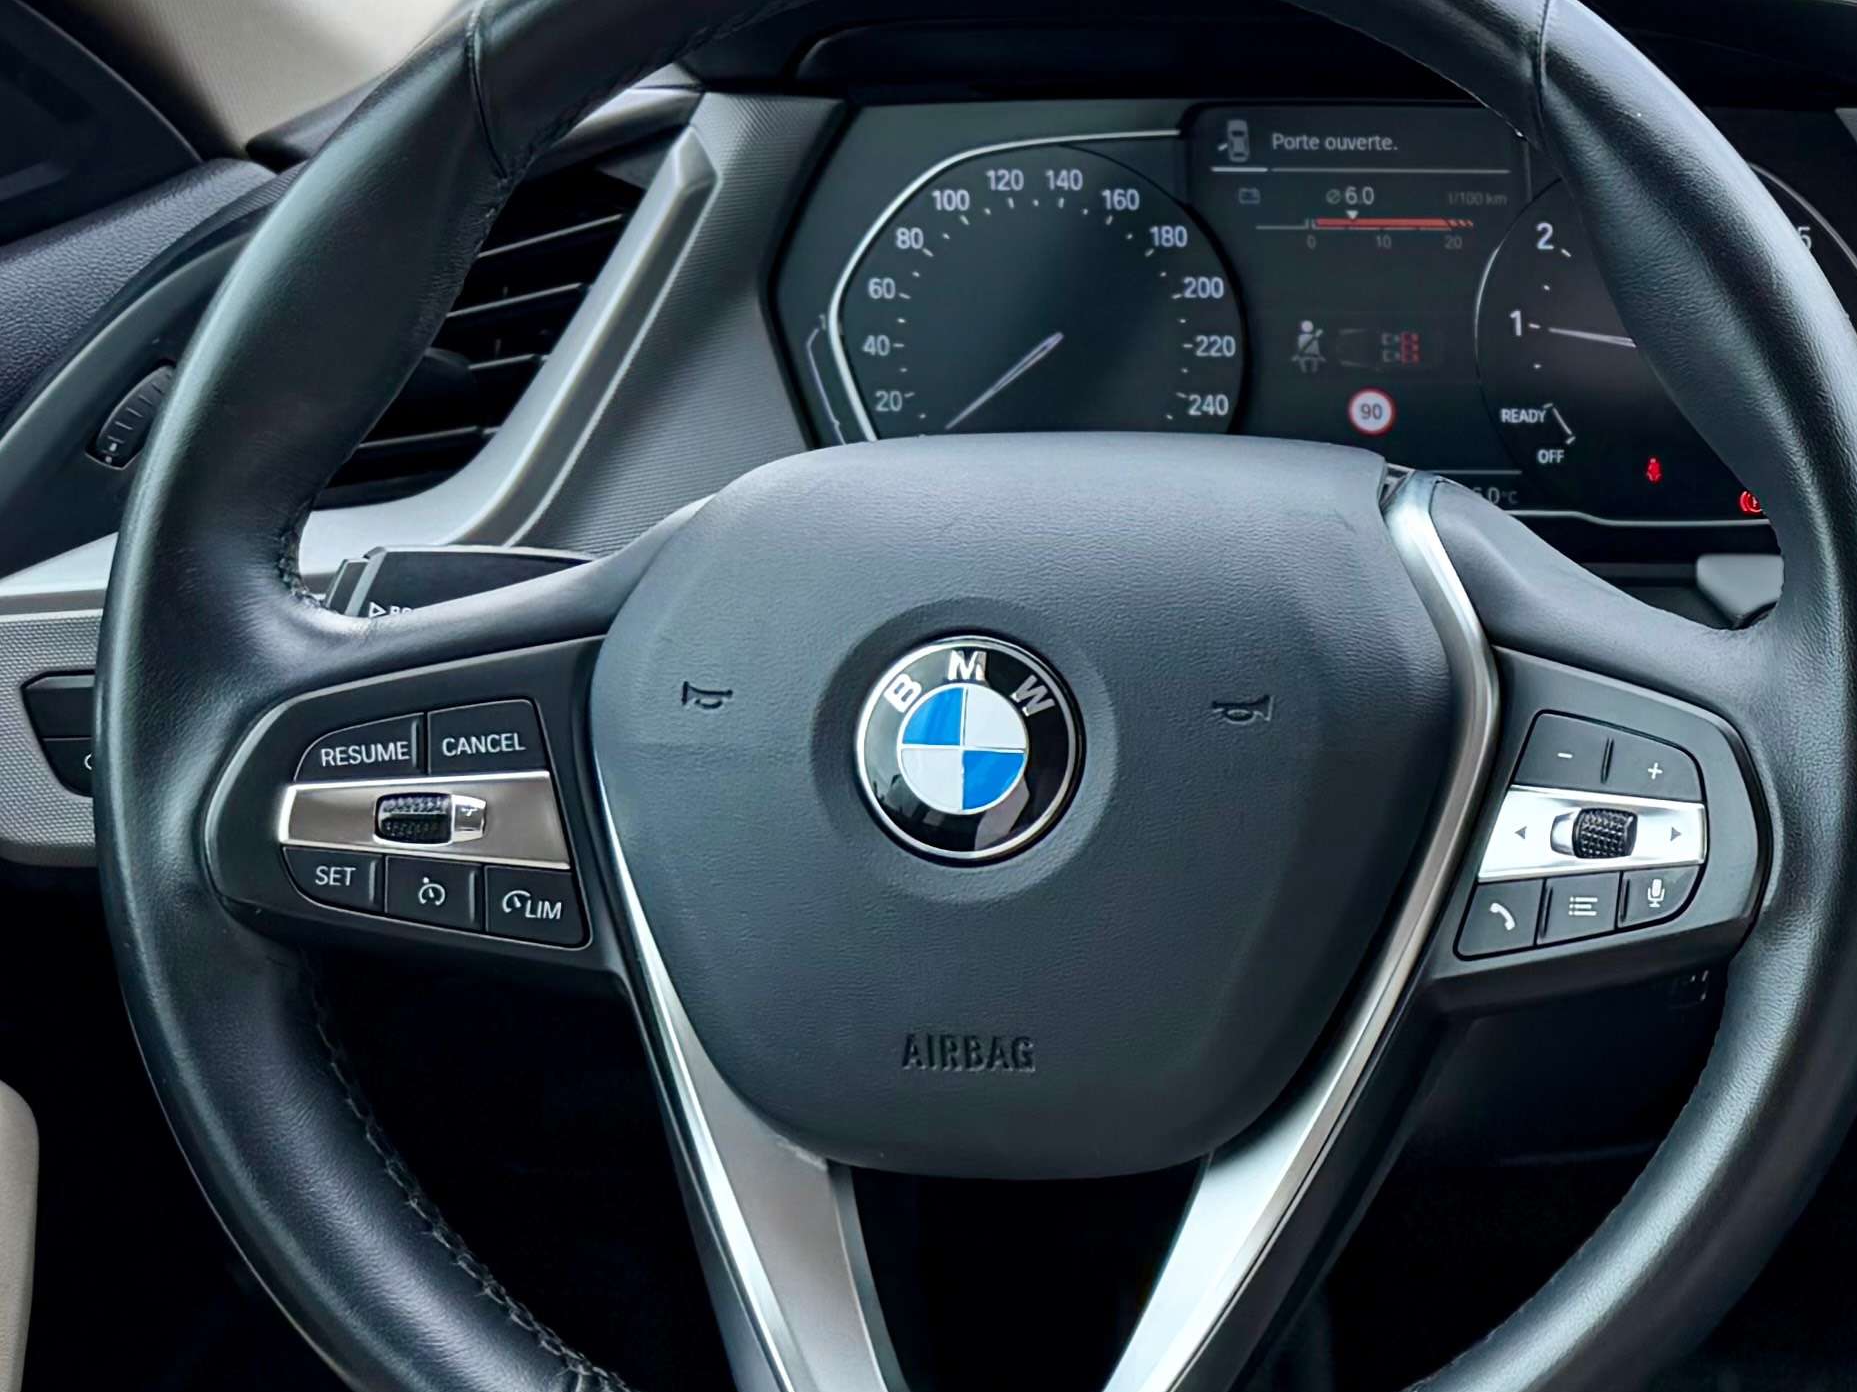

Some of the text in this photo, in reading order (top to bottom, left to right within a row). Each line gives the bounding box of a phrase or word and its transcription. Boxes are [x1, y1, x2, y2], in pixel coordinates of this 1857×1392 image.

[1272, 133, 1398, 151] Porte ouverte.
[987, 169, 1023, 191] 120
[1046, 169, 1083, 191] 140
[933, 190, 969, 211] 100
[1103, 189, 1140, 211] 160
[896, 227, 924, 250] 80
[1151, 226, 1188, 248] 180
[1376, 235, 1392, 249] 10
[1444, 235, 1463, 249] 20
[1536, 222, 1555, 250] 2
[868, 278, 896, 299] 60
[1184, 276, 1225, 298] 200
[1510, 309, 1522, 337] 1
[863, 334, 890, 356] 40
[1196, 335, 1236, 357] 220
[875, 390, 903, 411] 20
[1189, 394, 1229, 415] 240
[1361, 402, 1383, 421] 90
[1501, 408, 1546, 423] READY
[1537, 449, 1564, 464] OFF
[884, 650, 1056, 717] BMW
[320, 731, 526, 768] RESUME CANCEL
[314, 865, 356, 887] SET
[525, 894, 562, 920] LIM
[901, 1033, 1036, 1073] AIRBAG
